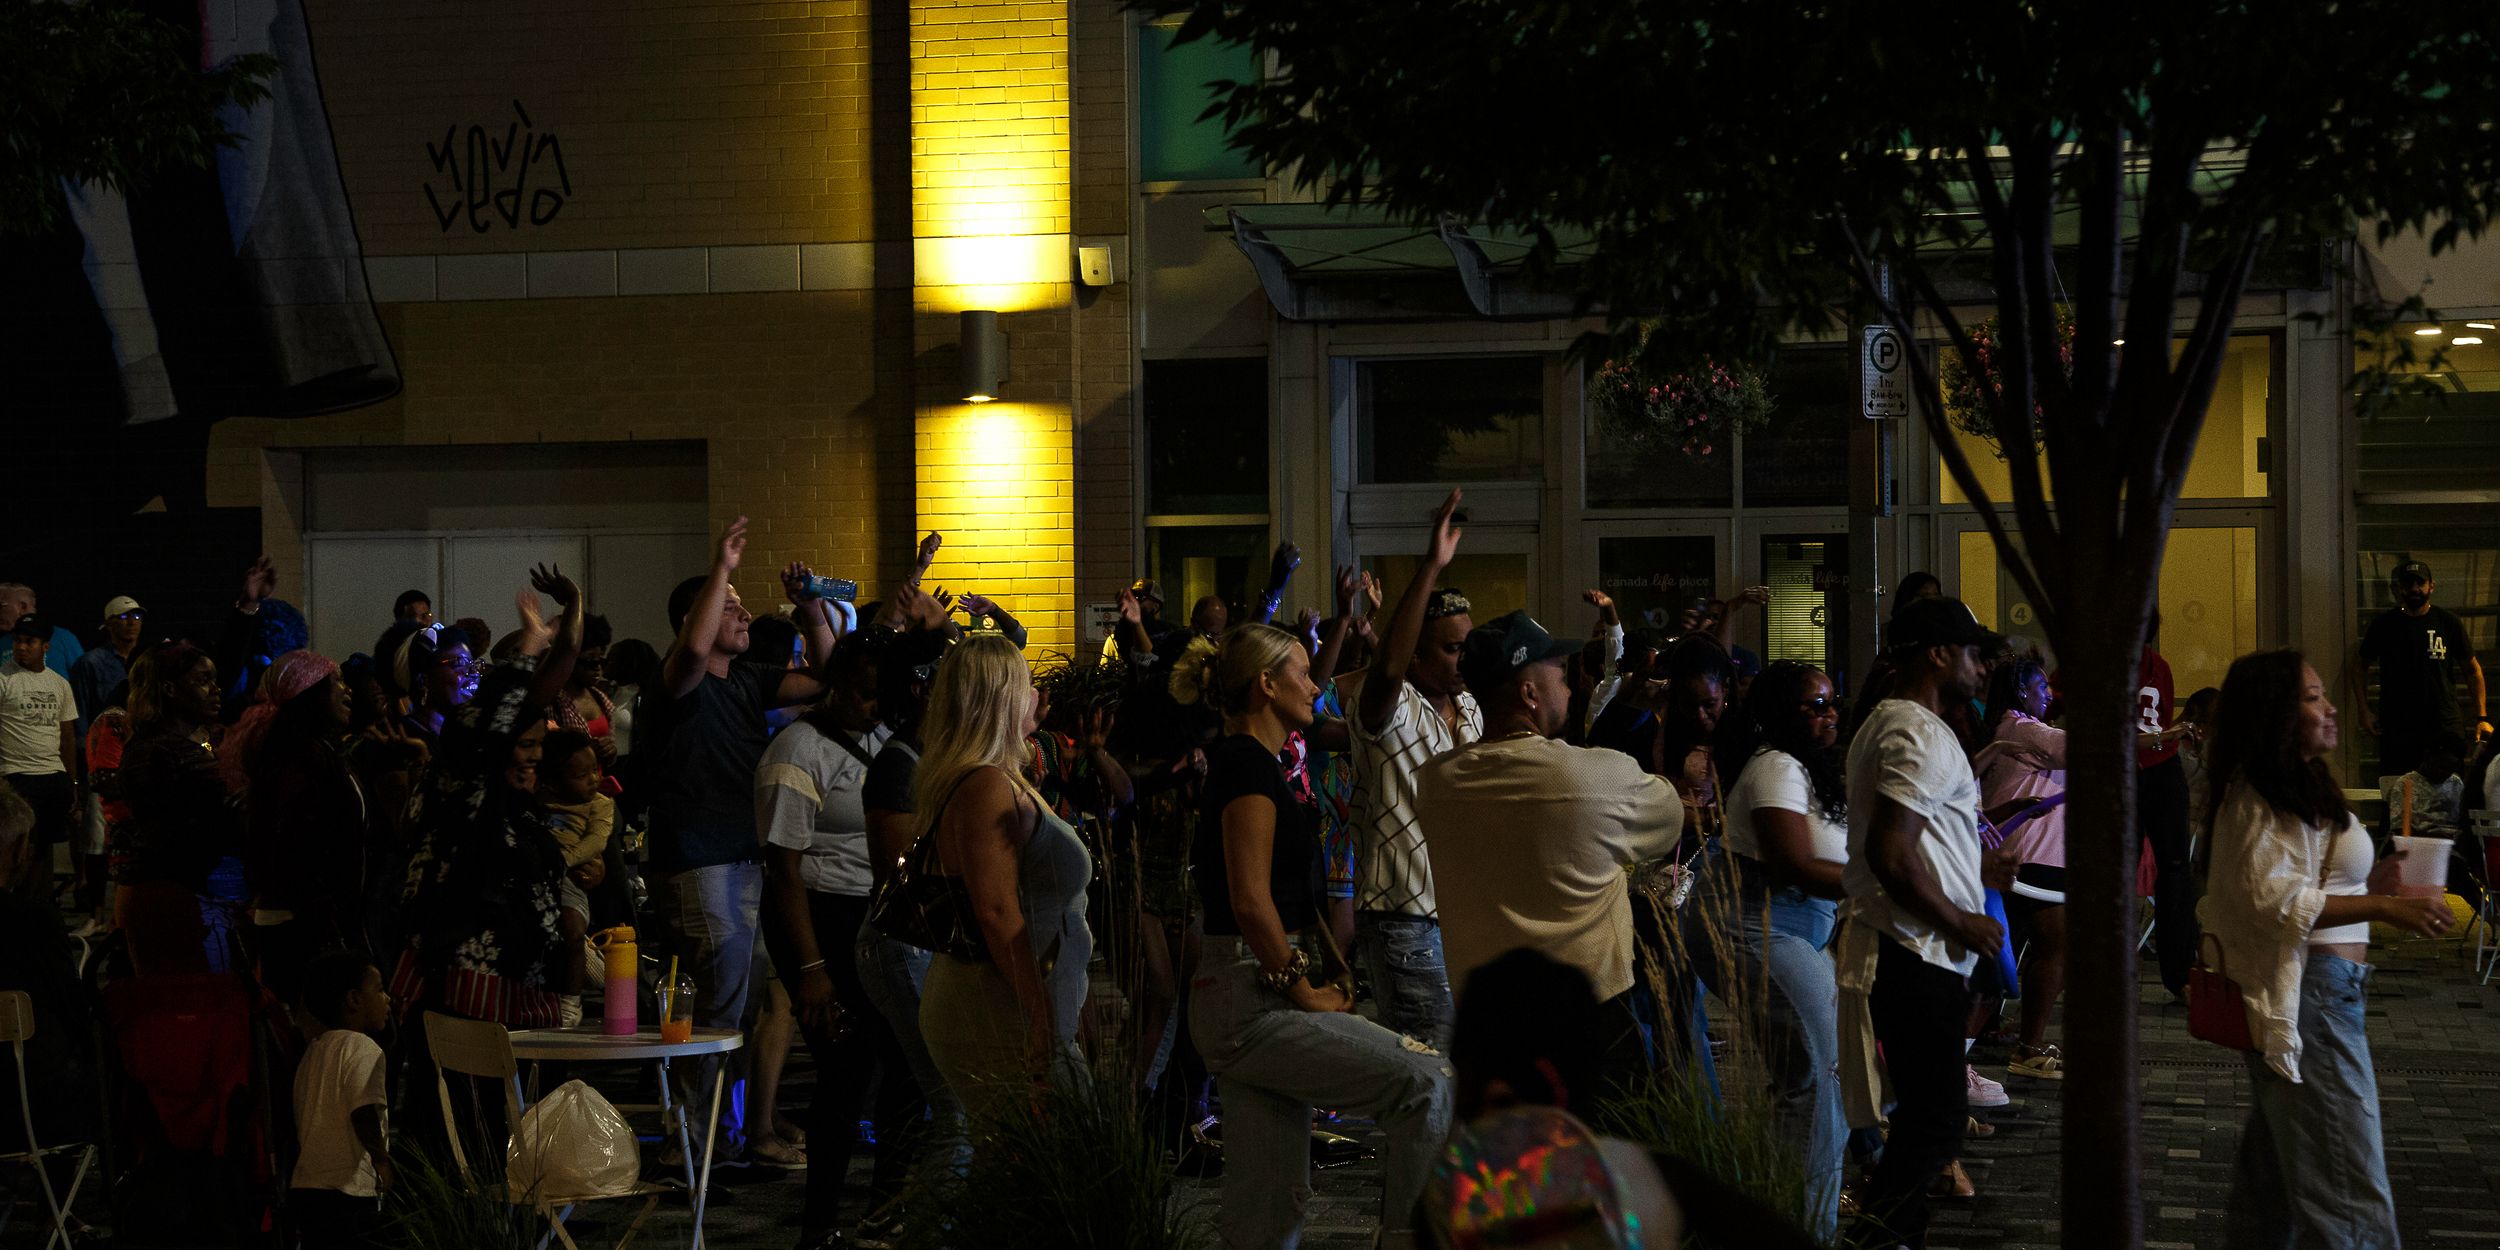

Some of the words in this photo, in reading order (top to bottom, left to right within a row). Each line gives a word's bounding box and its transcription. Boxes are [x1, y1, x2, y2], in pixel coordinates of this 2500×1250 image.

[1880, 342, 1895, 364] P
[1885, 379, 1895, 388] hr
[1607, 576, 1648, 587] canada
[1653, 573, 1677, 592] life
[1679, 576, 1710, 589] place
[2014, 607, 2027, 621] 4
[2427, 630, 2447, 660] LA
